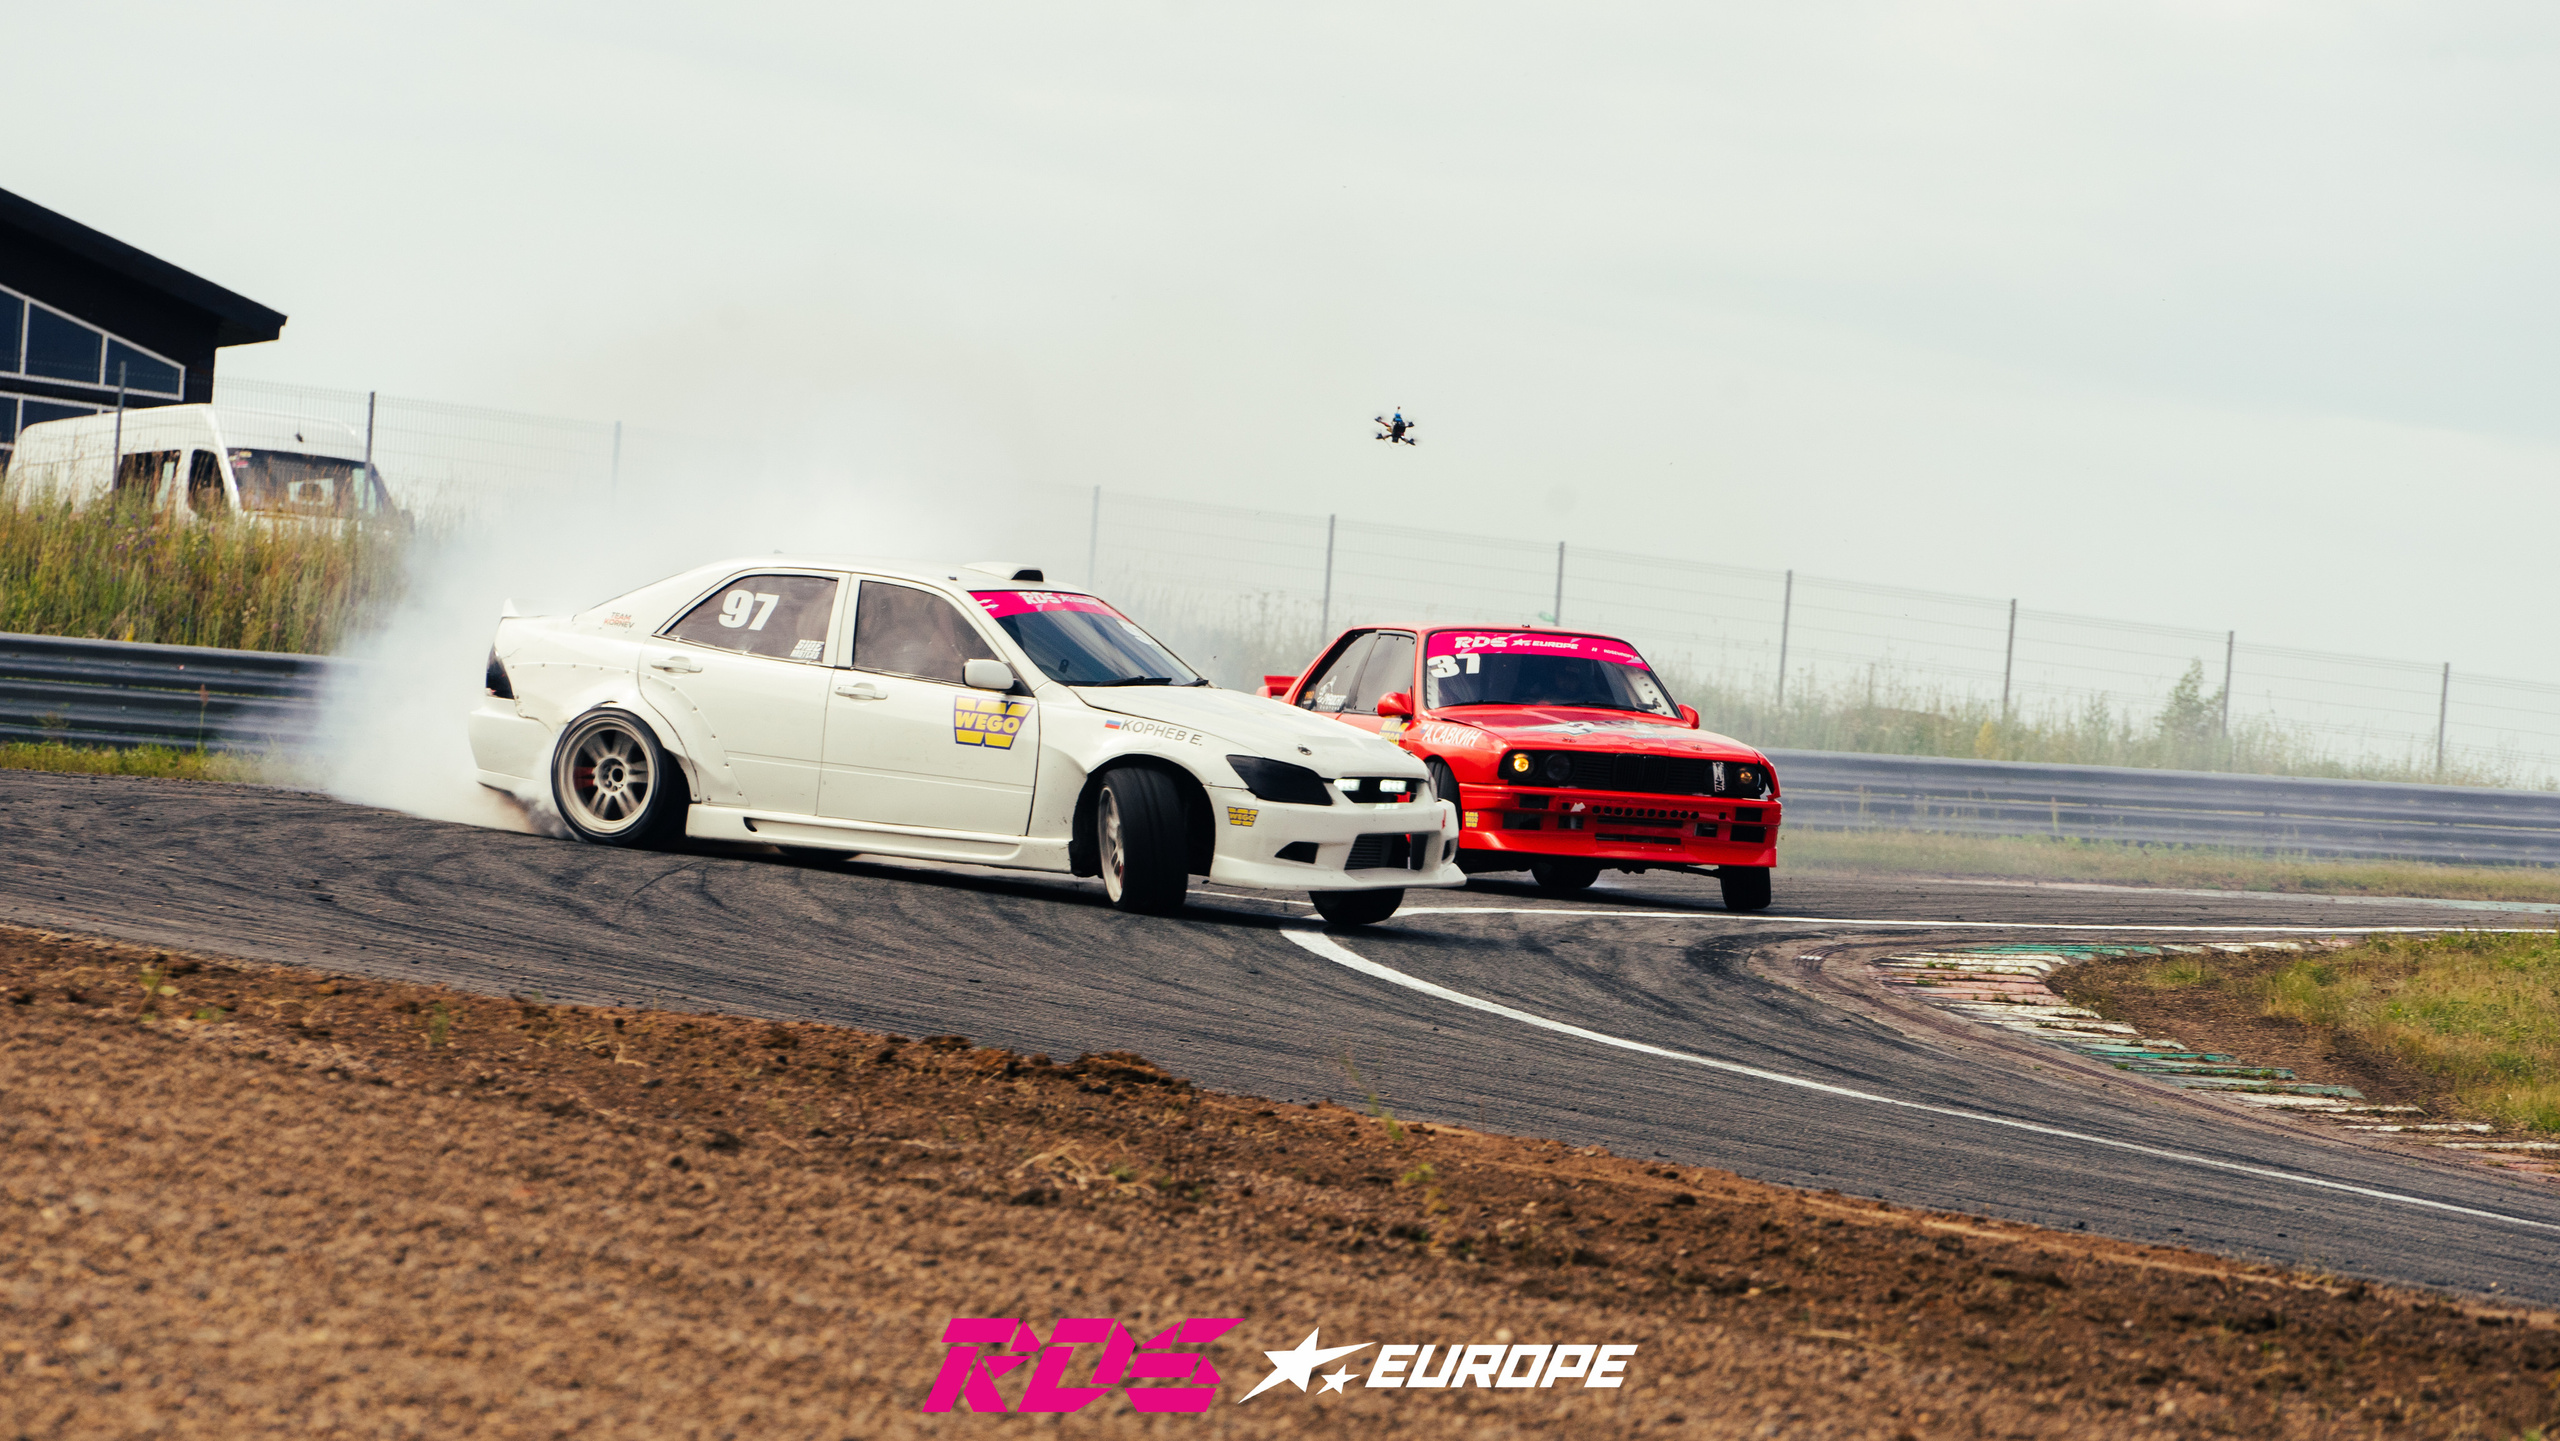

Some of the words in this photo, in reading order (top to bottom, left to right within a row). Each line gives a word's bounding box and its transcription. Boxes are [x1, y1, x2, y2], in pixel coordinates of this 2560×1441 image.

[611, 611, 632, 620] TEAM
[718, 589, 780, 631] 97
[604, 618, 635, 629] KORNEV
[1454, 636, 1508, 649] RDS
[1532, 640, 1579, 650] EUROPE
[955, 710, 1020, 734] WEGO
[1121, 720, 1187, 742] КОРНЕВ
[1189, 733, 1203, 746] Е.
